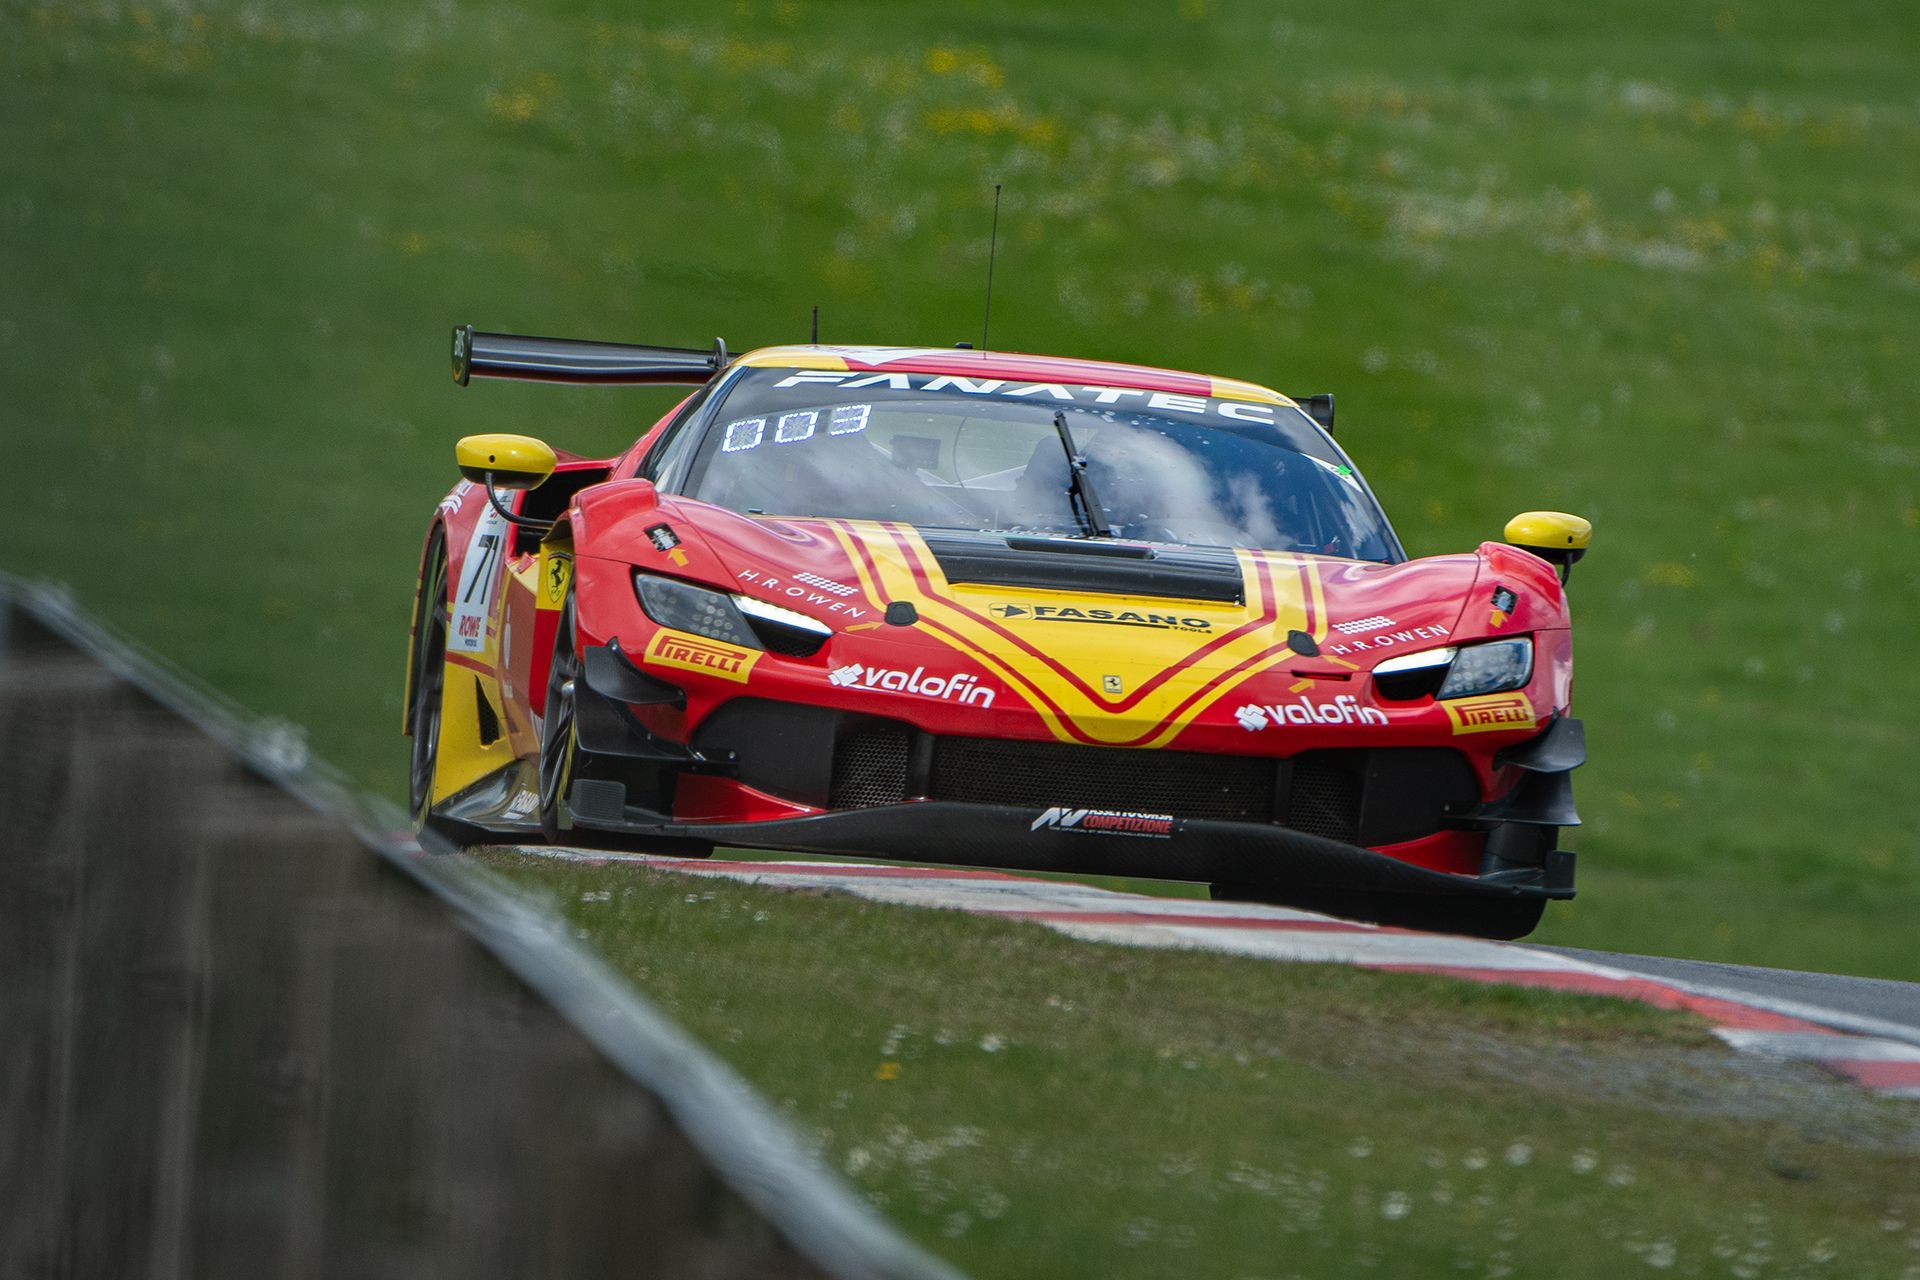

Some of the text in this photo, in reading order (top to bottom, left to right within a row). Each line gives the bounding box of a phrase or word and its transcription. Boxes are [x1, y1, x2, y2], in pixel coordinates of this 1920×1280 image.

[772, 370, 1276, 426] FANATEC
[458, 615, 483, 638] ROWE
[1034, 605, 1212, 629] FASANO
[1172, 625, 1213, 635] TOOLS
[653, 634, 749, 674] PIRELLI
[865, 667, 995, 708] valofin
[1269, 694, 1389, 726] valofin
[1452, 698, 1530, 728] PIRELLI
[1083, 815, 1173, 833] COMPETIZIONE
